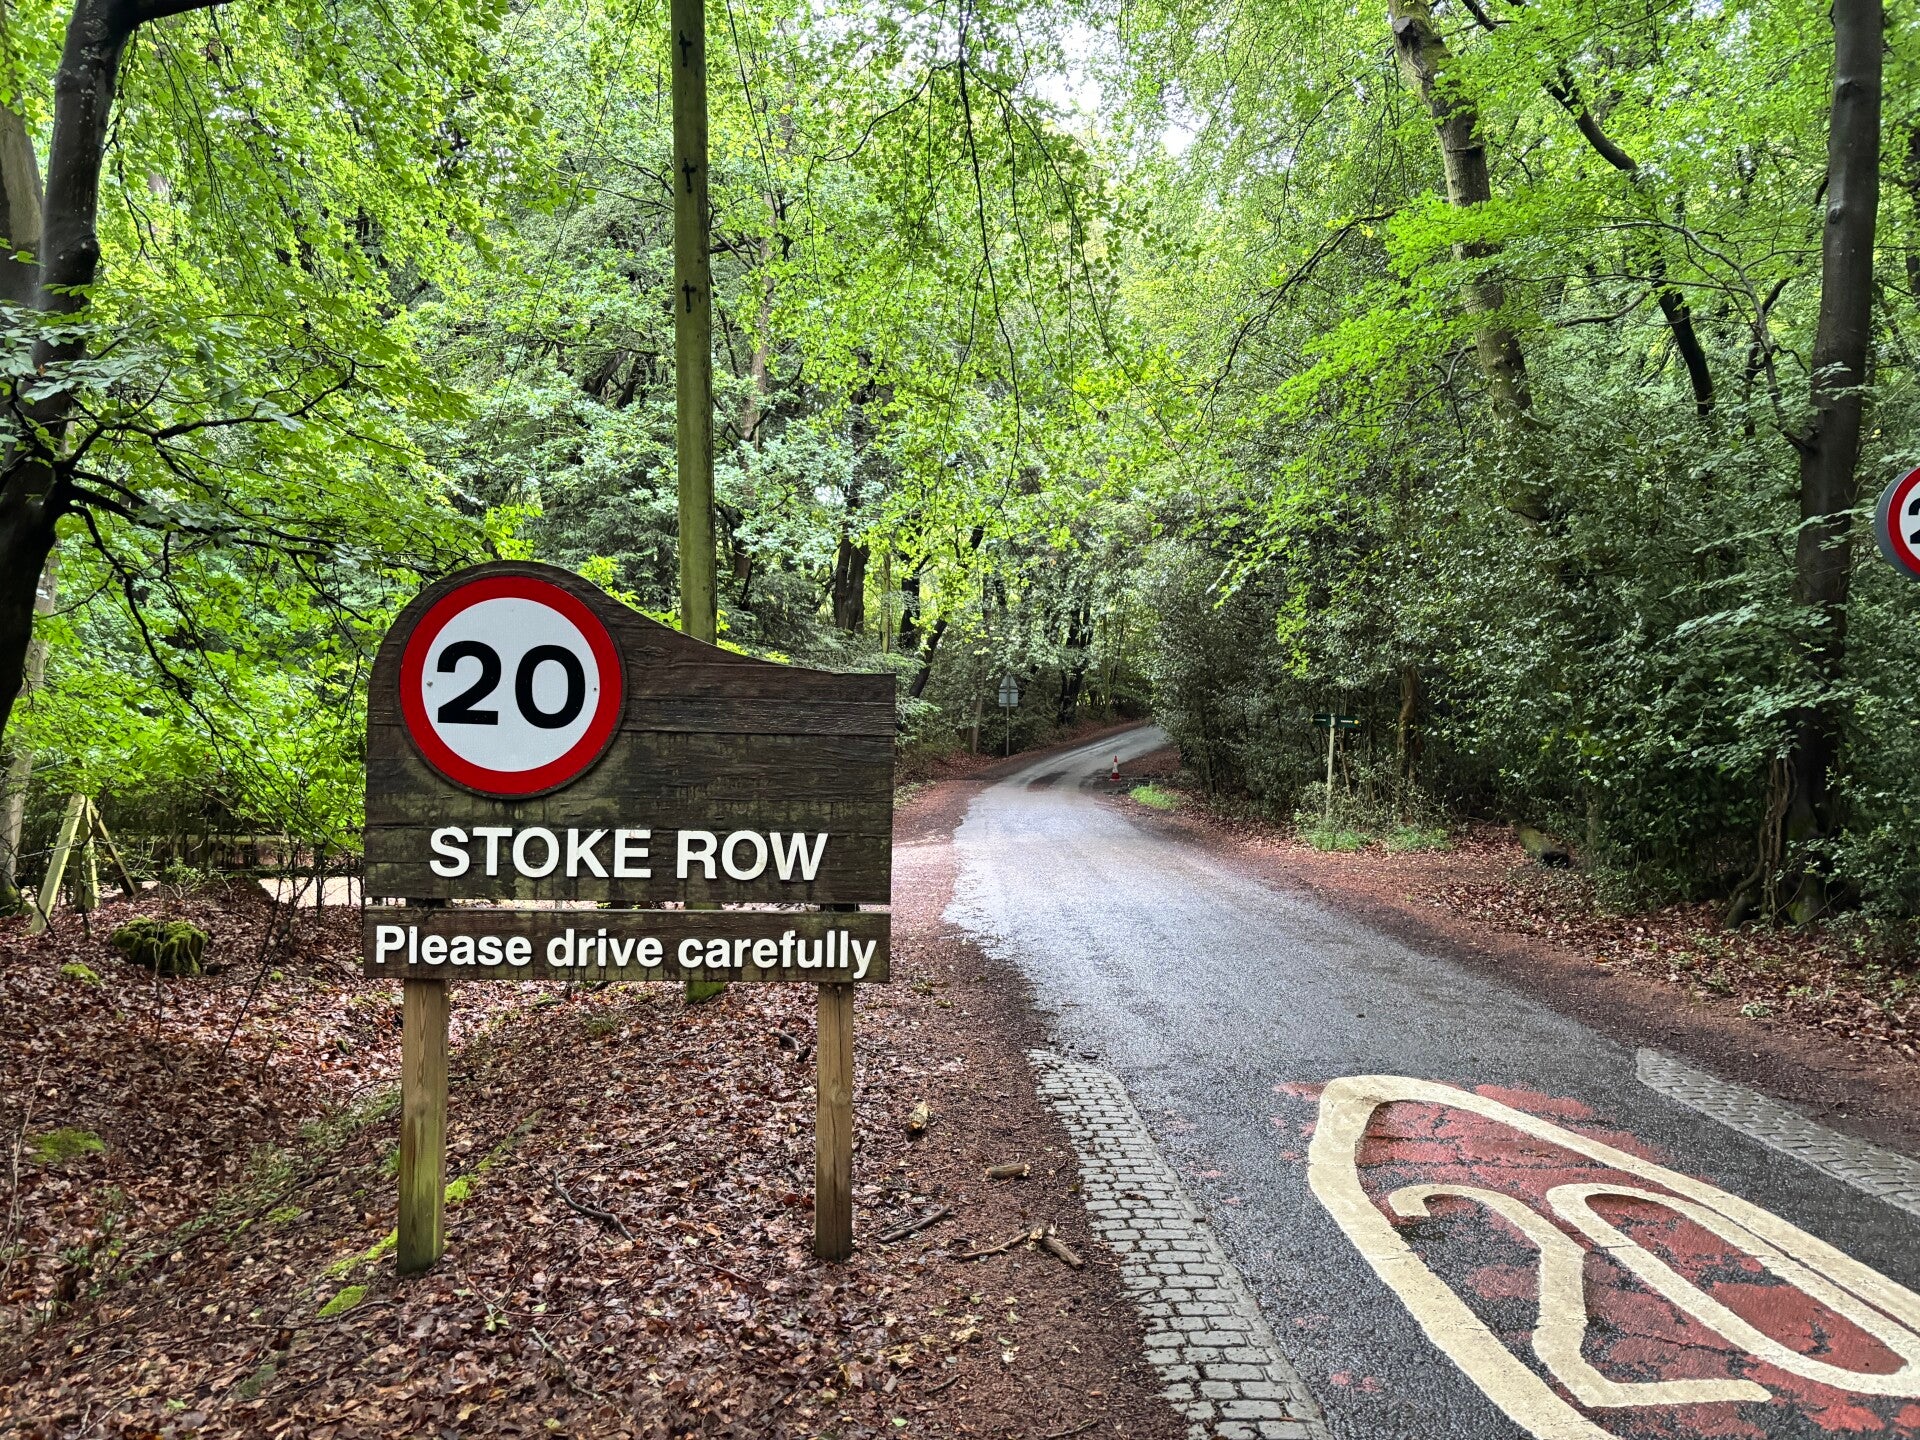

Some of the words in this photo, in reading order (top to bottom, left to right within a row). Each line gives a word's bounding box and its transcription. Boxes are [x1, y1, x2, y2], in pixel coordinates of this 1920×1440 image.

[436, 640, 586, 729] 20
[429, 826, 651, 879] STOKE
[676, 830, 828, 881] ROW
[375, 925, 531, 967] Please
[546, 928, 663, 969] drive
[677, 930, 877, 979] carefully
[1389, 1183, 1920, 1408] 20
